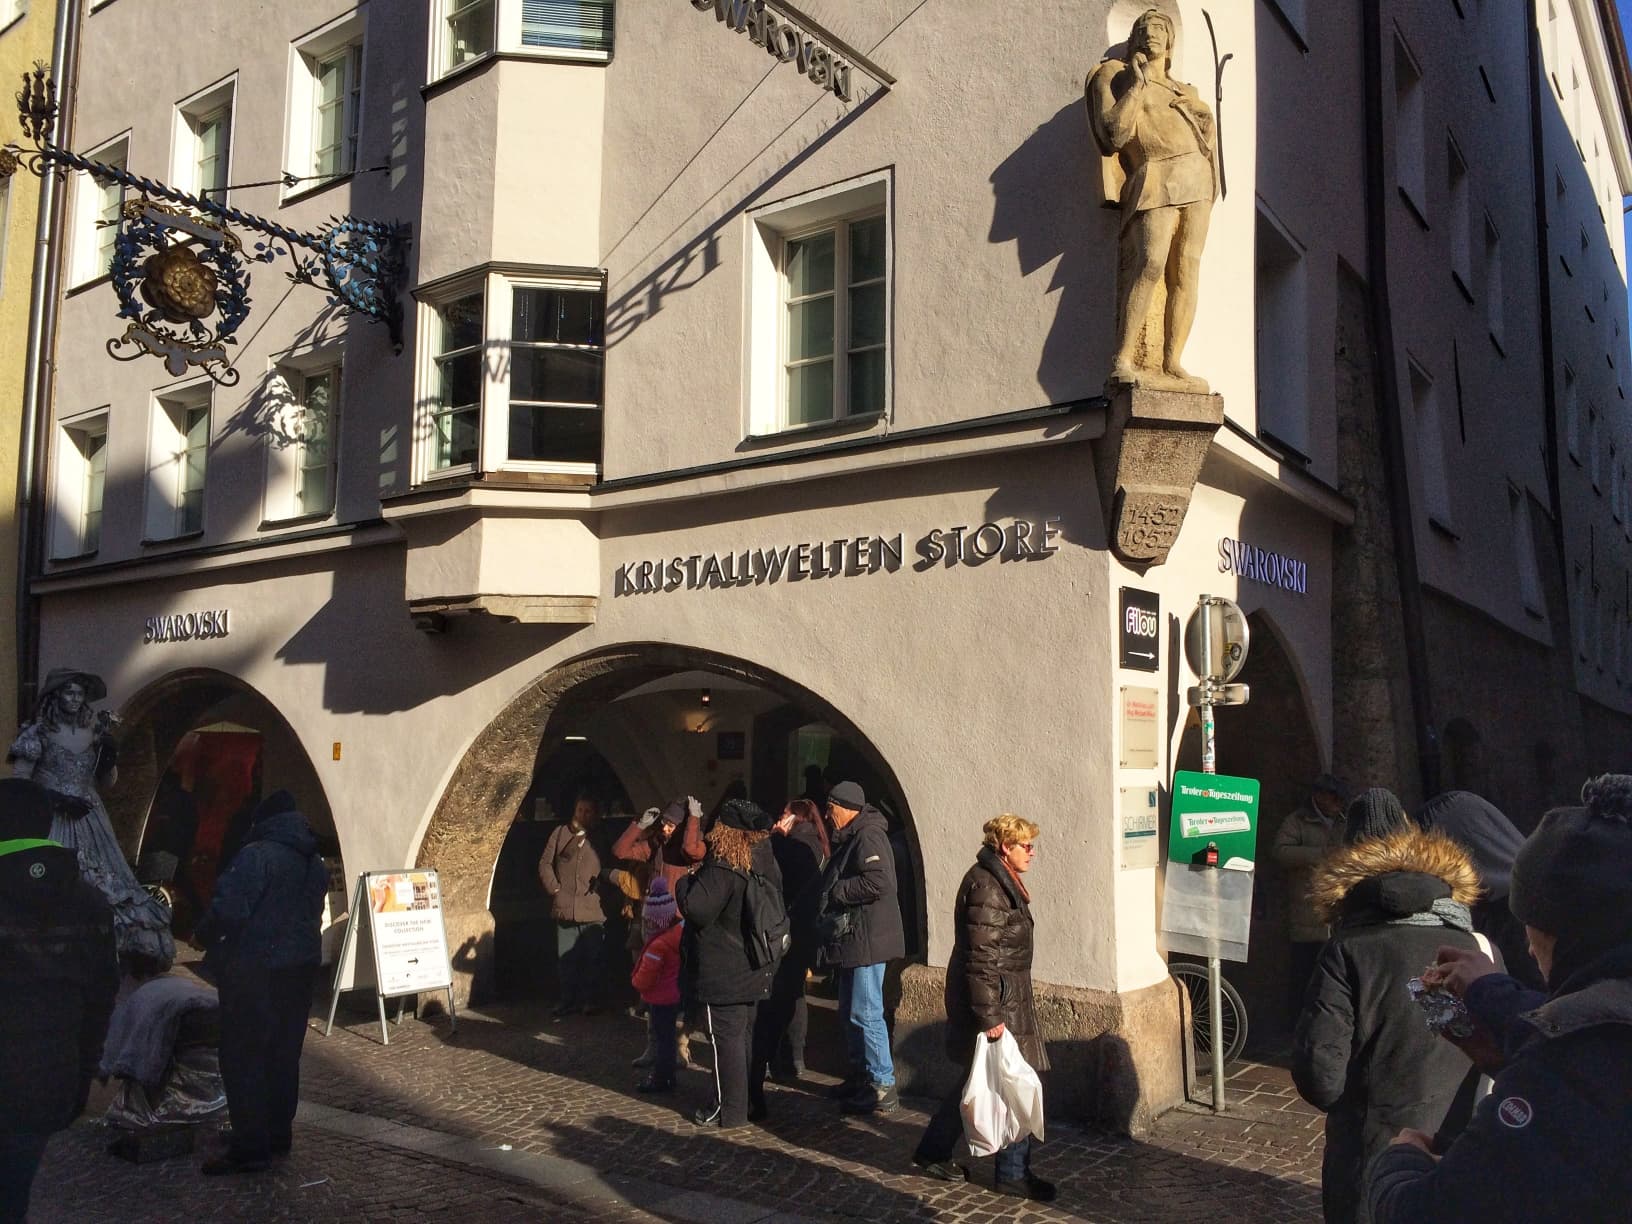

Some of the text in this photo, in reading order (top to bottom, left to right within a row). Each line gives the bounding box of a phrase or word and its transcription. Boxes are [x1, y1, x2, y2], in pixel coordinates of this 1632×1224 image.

[690, 0, 851, 102] WAROVSKI
[1129, 503, 1179, 526] 1452
[620, 515, 1061, 593] KRISTALLWELTEN STORE
[1218, 537, 1308, 593] SWAROVSKI
[145, 609, 230, 640] SWAROVSKI
[1126, 606, 1157, 638] Filou
[1180, 785, 1254, 804] Tiroler Tageszeitung
